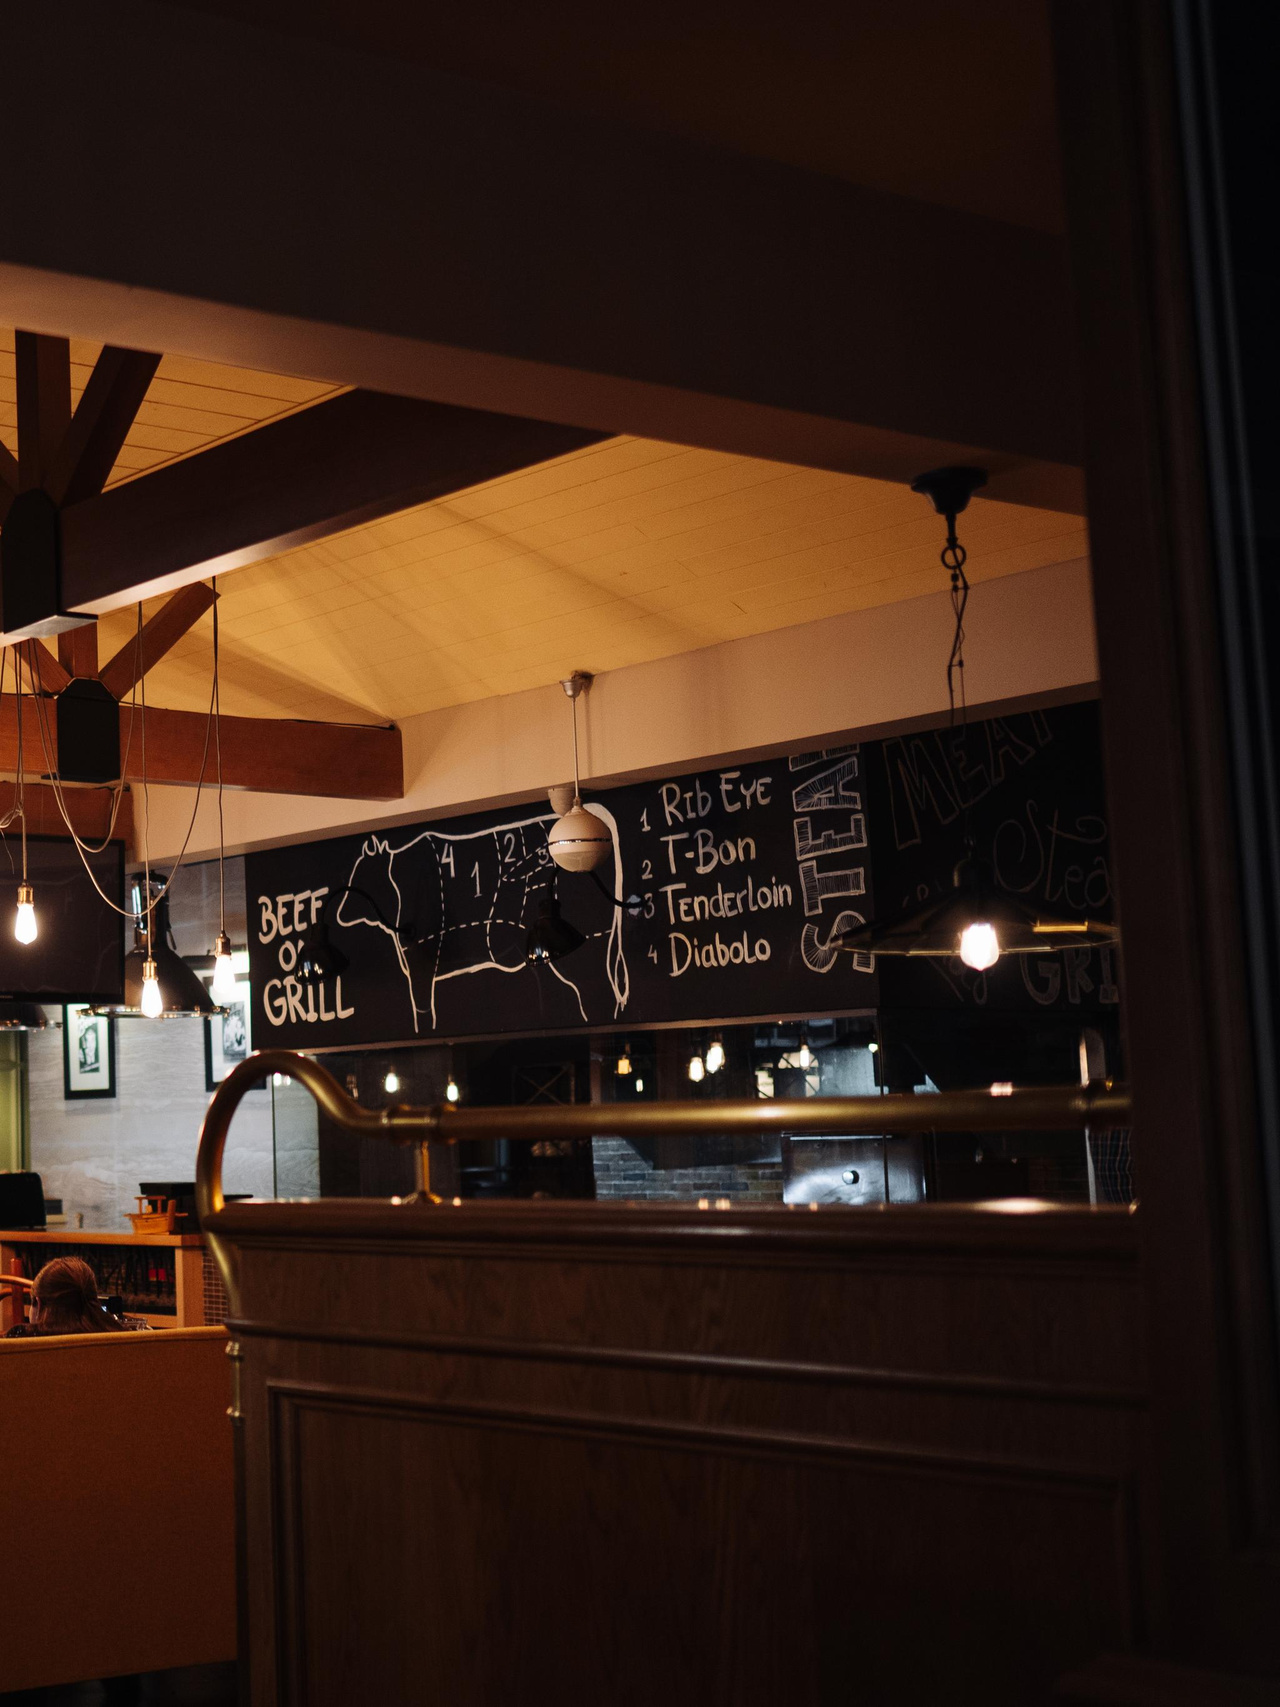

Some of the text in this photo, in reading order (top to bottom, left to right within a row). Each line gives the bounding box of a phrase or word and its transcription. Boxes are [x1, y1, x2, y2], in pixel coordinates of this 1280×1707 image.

[441, 842, 456, 879] 4
[503, 832, 517, 863] 2
[641, 828, 757, 880] 2 T-Bon
[788, 743, 876, 974] STEA
[257, 886, 330, 945] BEEF
[658, 874, 793, 925] Tenderloin
[667, 929, 771, 978] Diabolo
[263, 974, 355, 1027] GRILL
